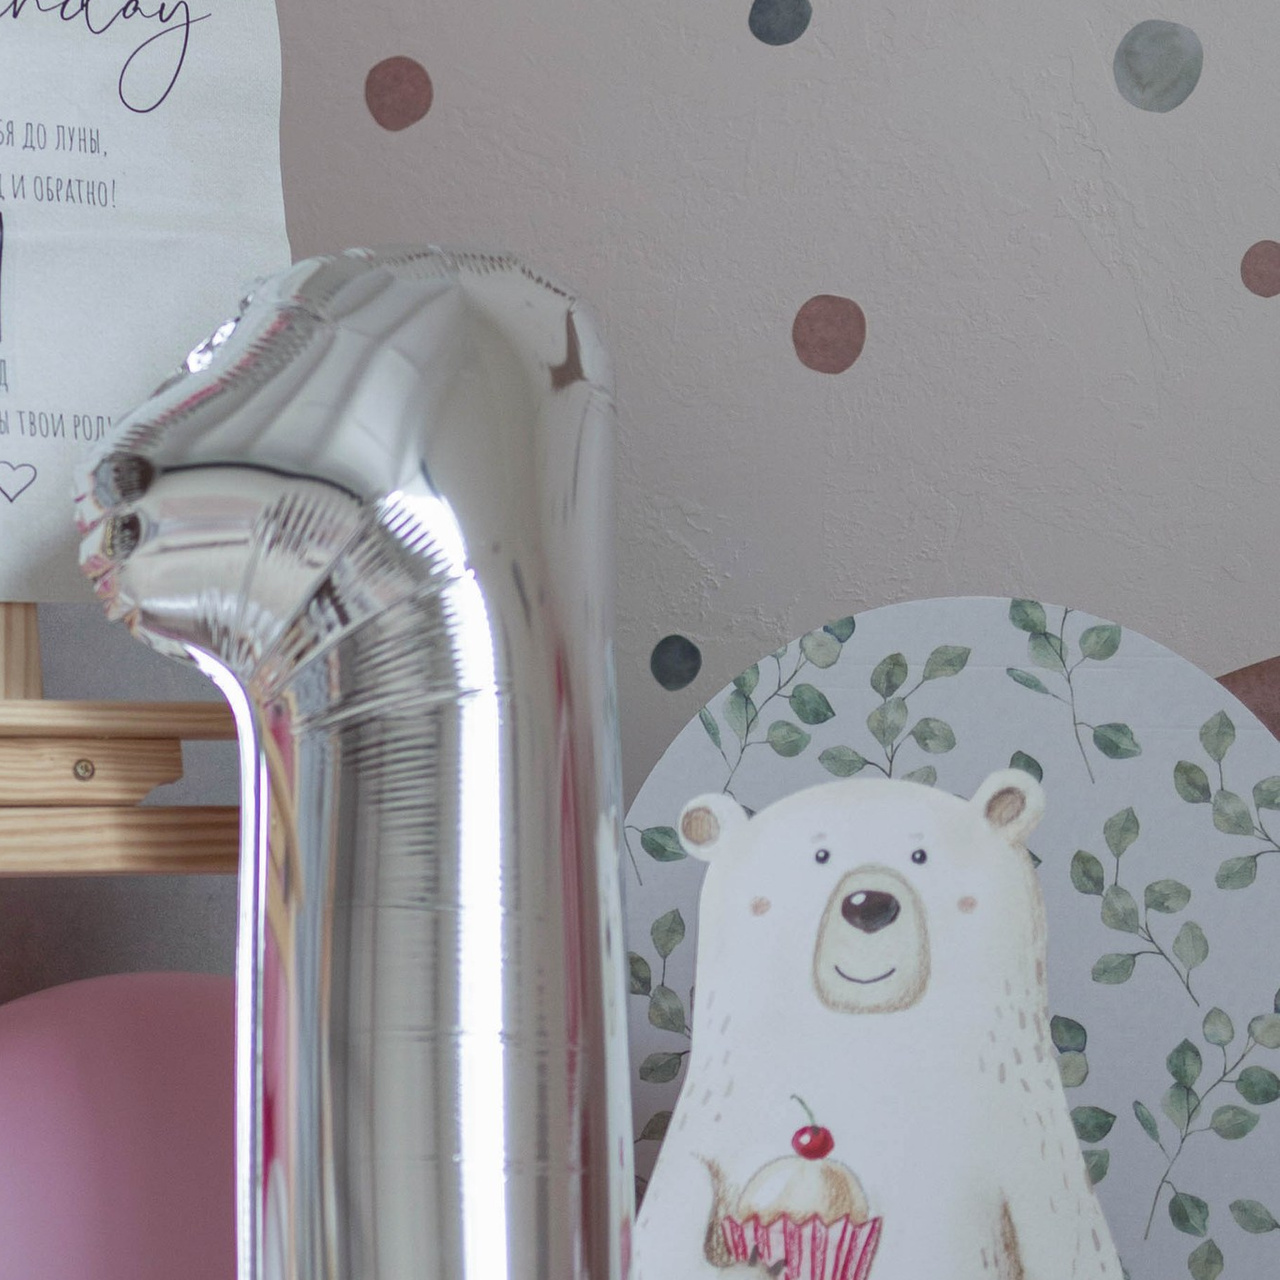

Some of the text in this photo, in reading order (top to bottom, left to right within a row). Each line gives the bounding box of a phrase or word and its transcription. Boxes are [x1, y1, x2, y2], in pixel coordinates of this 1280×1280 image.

[21, 121, 47, 152] ДО
[54, 124, 108, 158] ЛУНЫ,
[11, 173, 26, 201] И
[33, 175, 117, 209] ОБРАТНО!
[16, 410, 66, 439] ТВОИ
